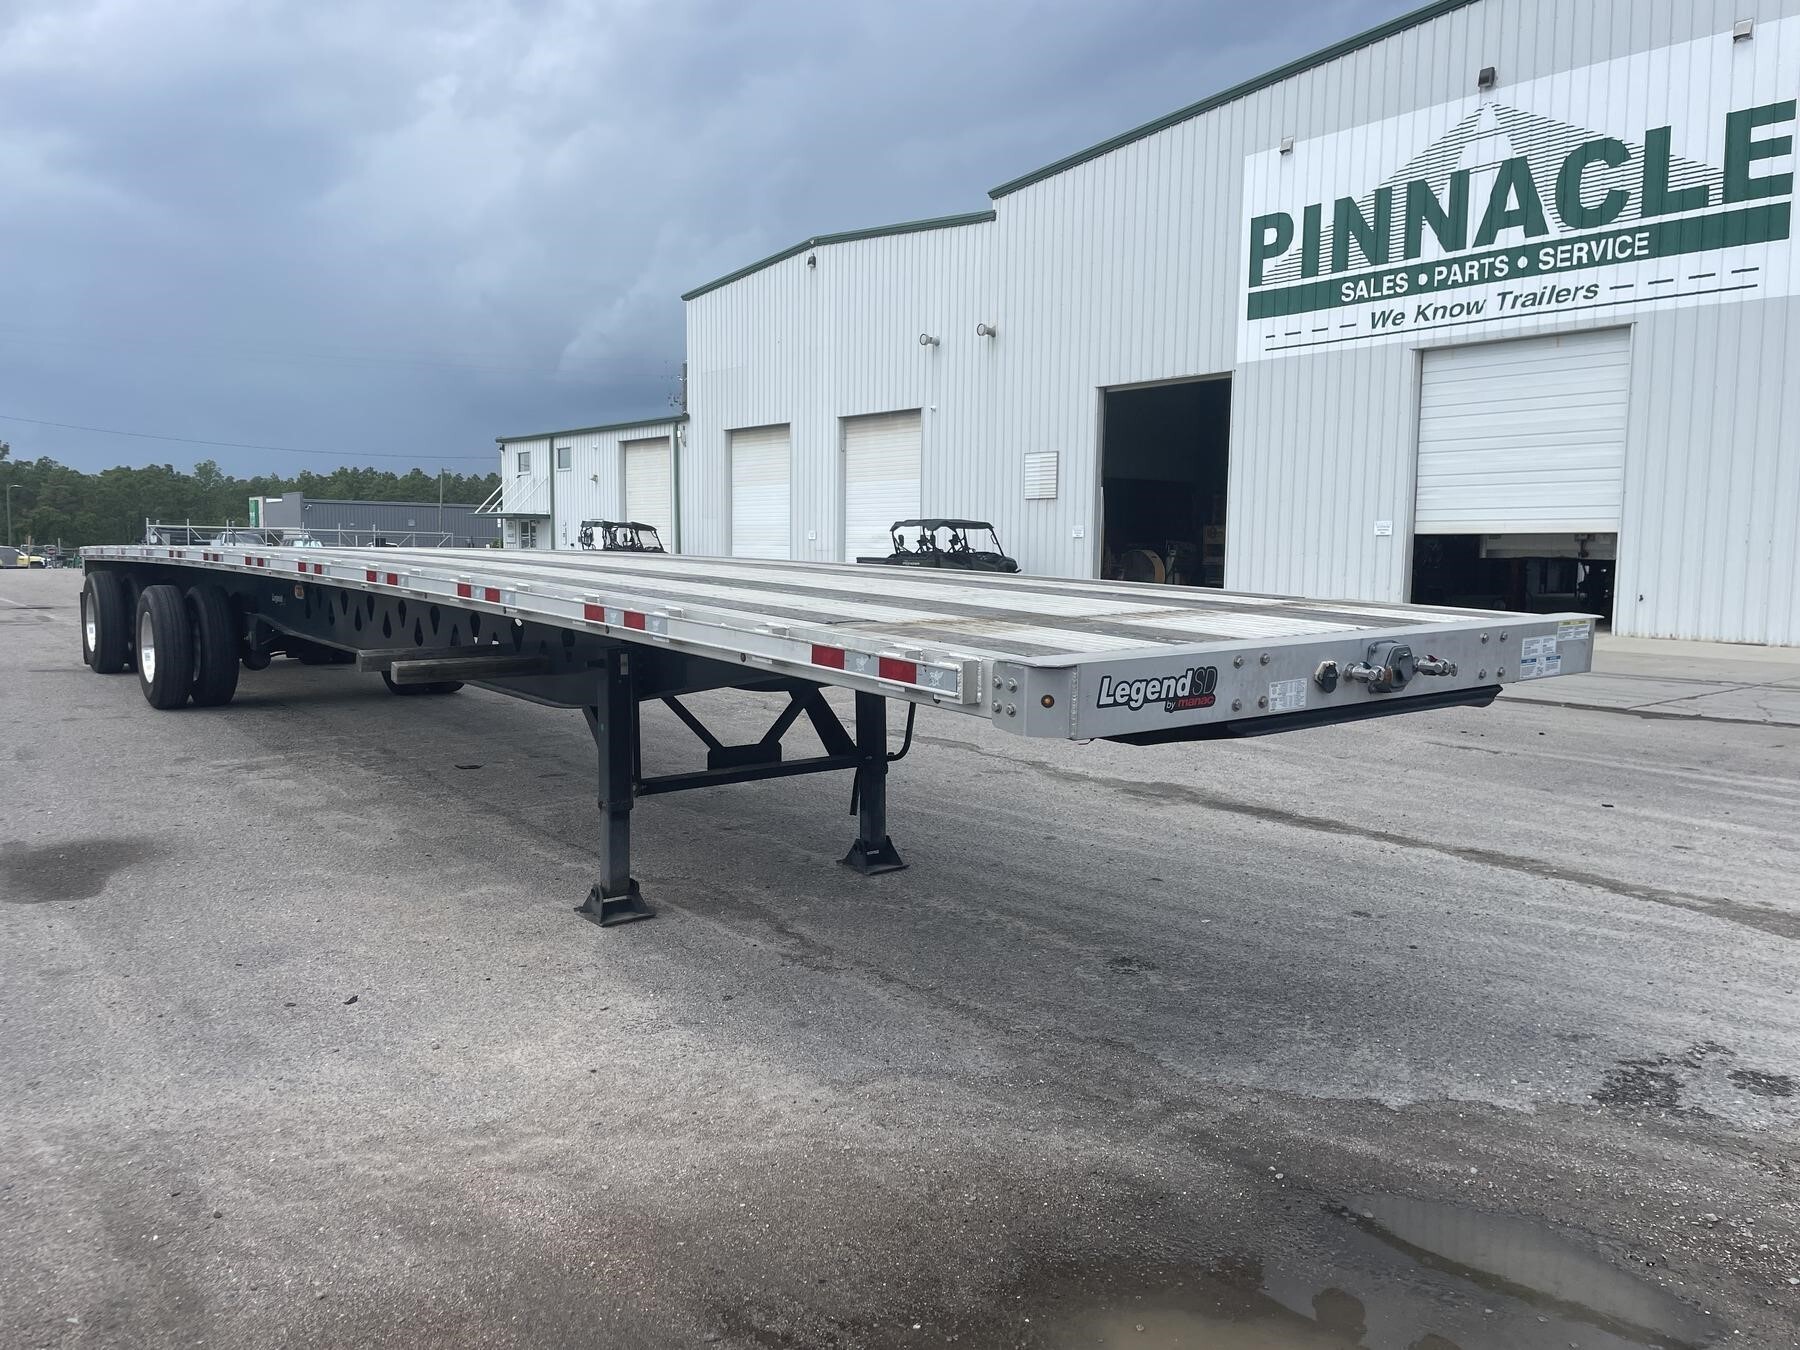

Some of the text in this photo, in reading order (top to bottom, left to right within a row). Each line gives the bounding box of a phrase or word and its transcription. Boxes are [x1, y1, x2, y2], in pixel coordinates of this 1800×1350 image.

[1249, 98, 1797, 288] PINNACLE
[1341, 237, 1650, 302] SALES PARTS SERVICE
[1371, 282, 1600, 329] We Know Trailers
[1166, 696, 1215, 710] by manac
